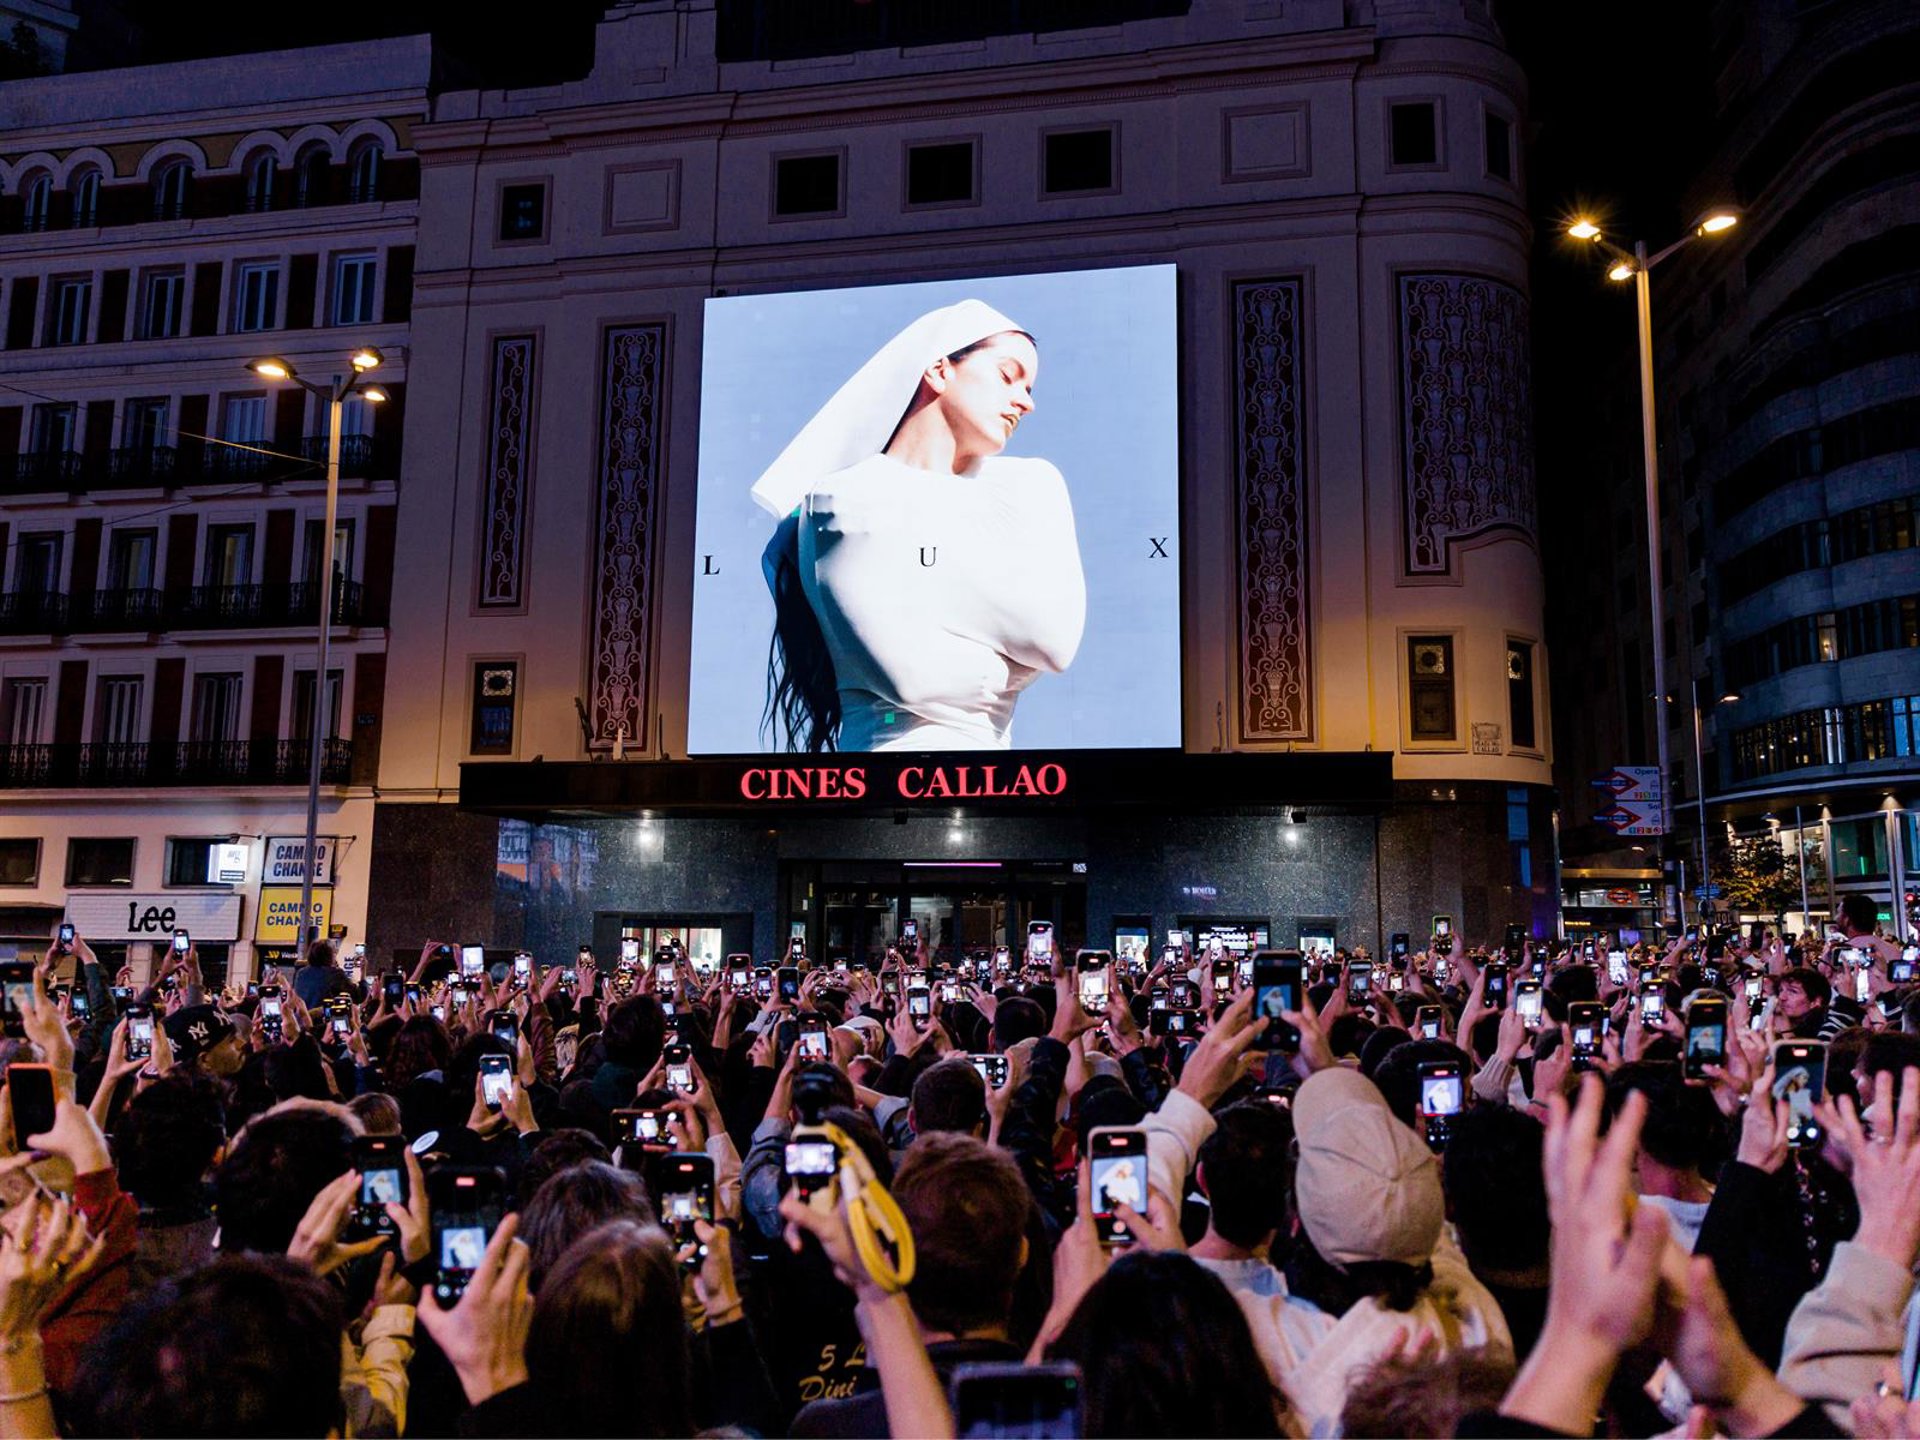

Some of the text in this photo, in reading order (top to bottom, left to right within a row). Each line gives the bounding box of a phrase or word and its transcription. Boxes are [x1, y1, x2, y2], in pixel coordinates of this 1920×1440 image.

[703, 536, 1169, 576] L U X
[740, 763, 1067, 799] CINES CALLAO
[276, 845, 326, 860] CAMO
[128, 902, 176, 933] Lee
[269, 903, 323, 912] CAMO
[816, 1343, 838, 1372] 5
